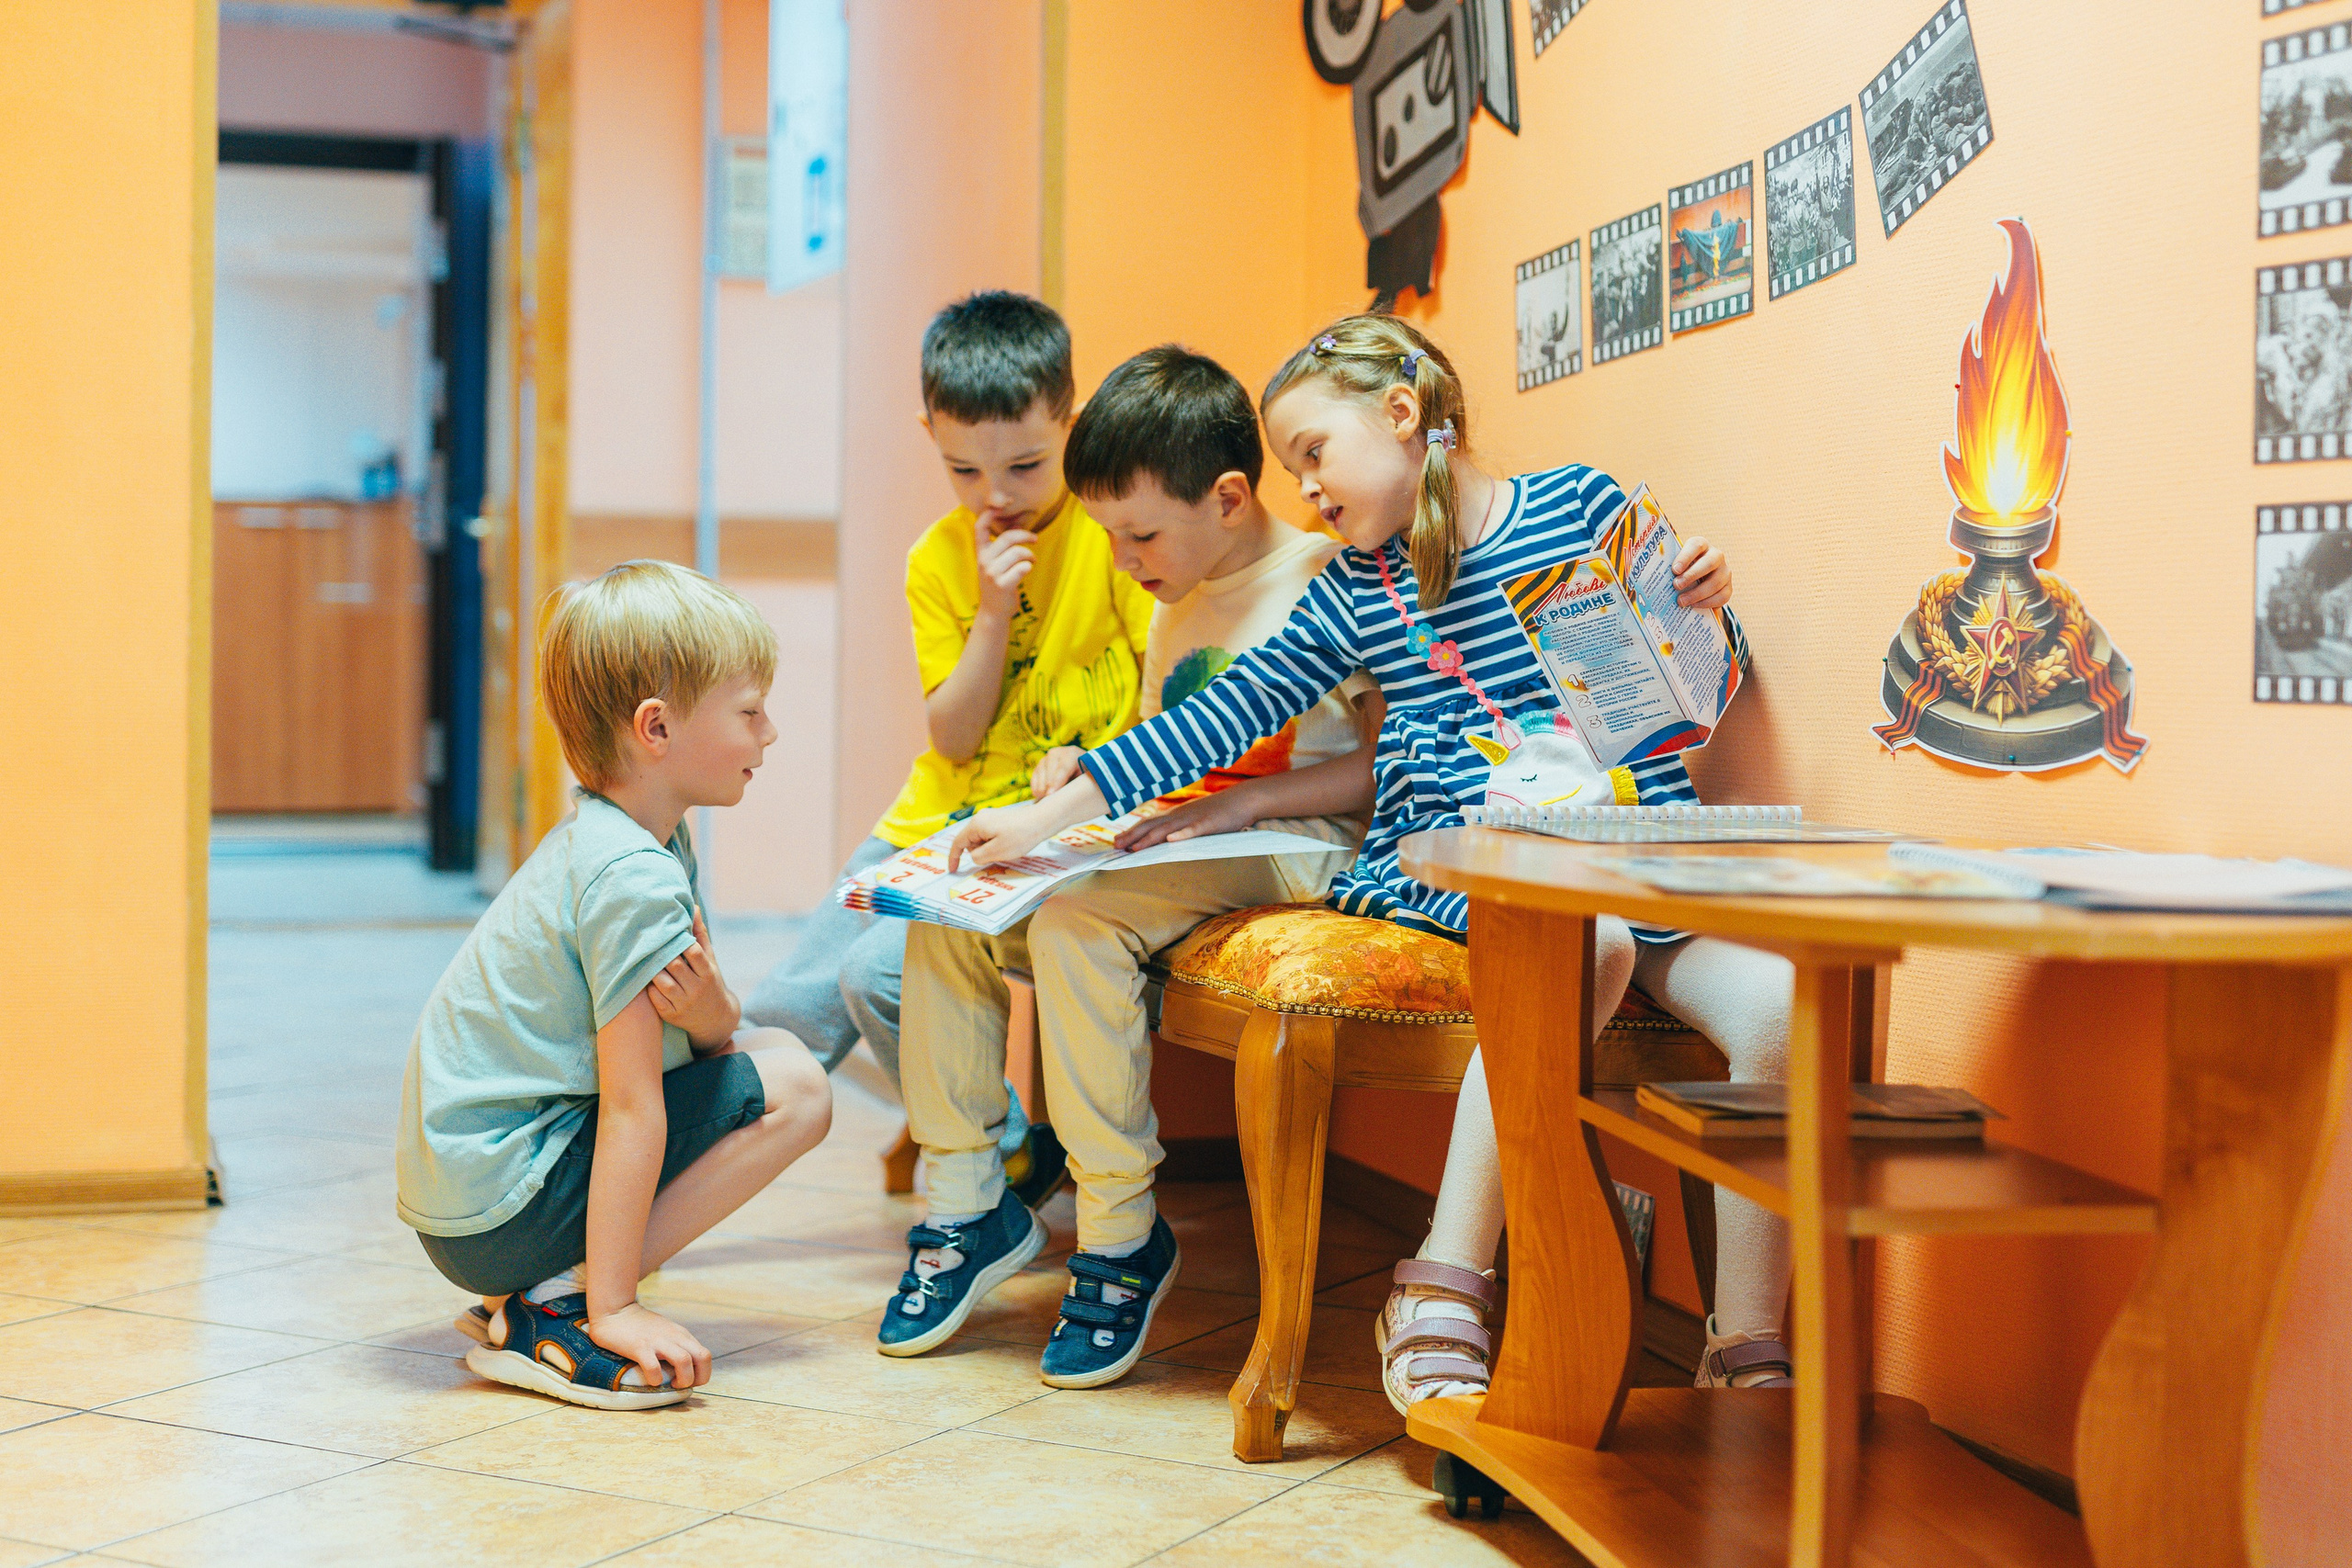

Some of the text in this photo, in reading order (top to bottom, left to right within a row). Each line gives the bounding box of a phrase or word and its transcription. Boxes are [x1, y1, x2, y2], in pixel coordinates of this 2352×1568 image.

[1624, 515, 1657, 578] История
[1631, 525, 1667, 581] КУЛЬТУРА
[1533, 578, 1605, 615] Любовь
[1534, 592, 1614, 626] К РОДИНЕ
[1567, 674, 1579, 686] 1
[1576, 694, 1591, 706] 2
[1587, 715, 1601, 728] 3
[957, 887, 996, 905] 27
